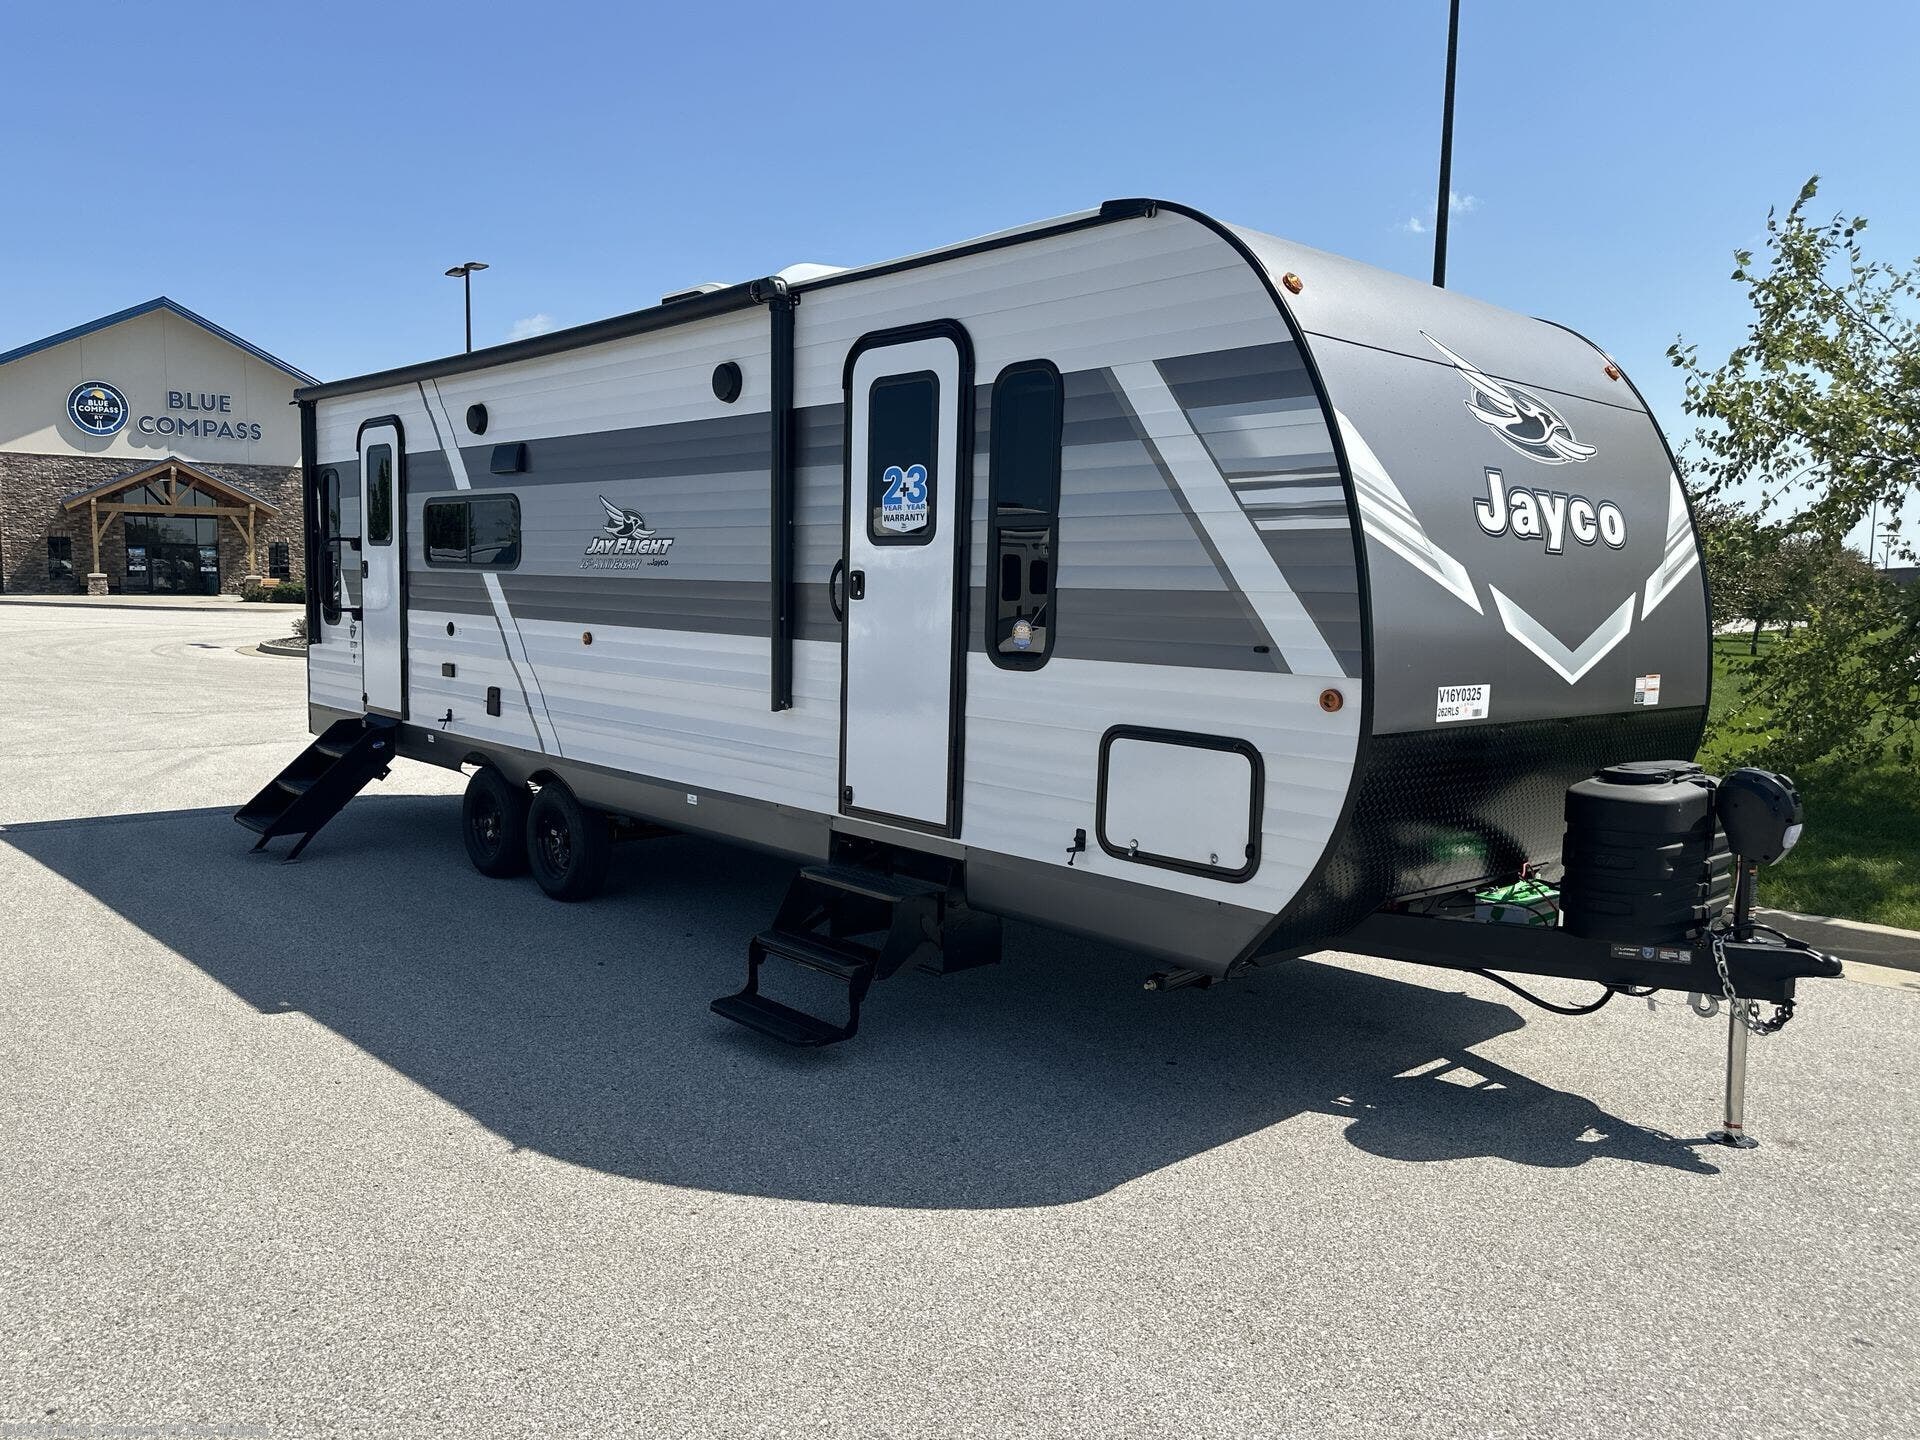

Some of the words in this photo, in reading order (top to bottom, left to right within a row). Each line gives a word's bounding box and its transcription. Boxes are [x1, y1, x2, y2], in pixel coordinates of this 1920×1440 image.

[88, 399, 109, 407] BLUE
[168, 391, 231, 412] BLUE
[78, 405, 119, 414] COMPASS
[138, 416, 262, 440] COMPASS
[907, 503, 926, 511] YEAR
[1472, 466, 1627, 555] Jayco
[883, 513, 926, 522] WARRANTY
[1439, 687, 1482, 703] V16Y0325
